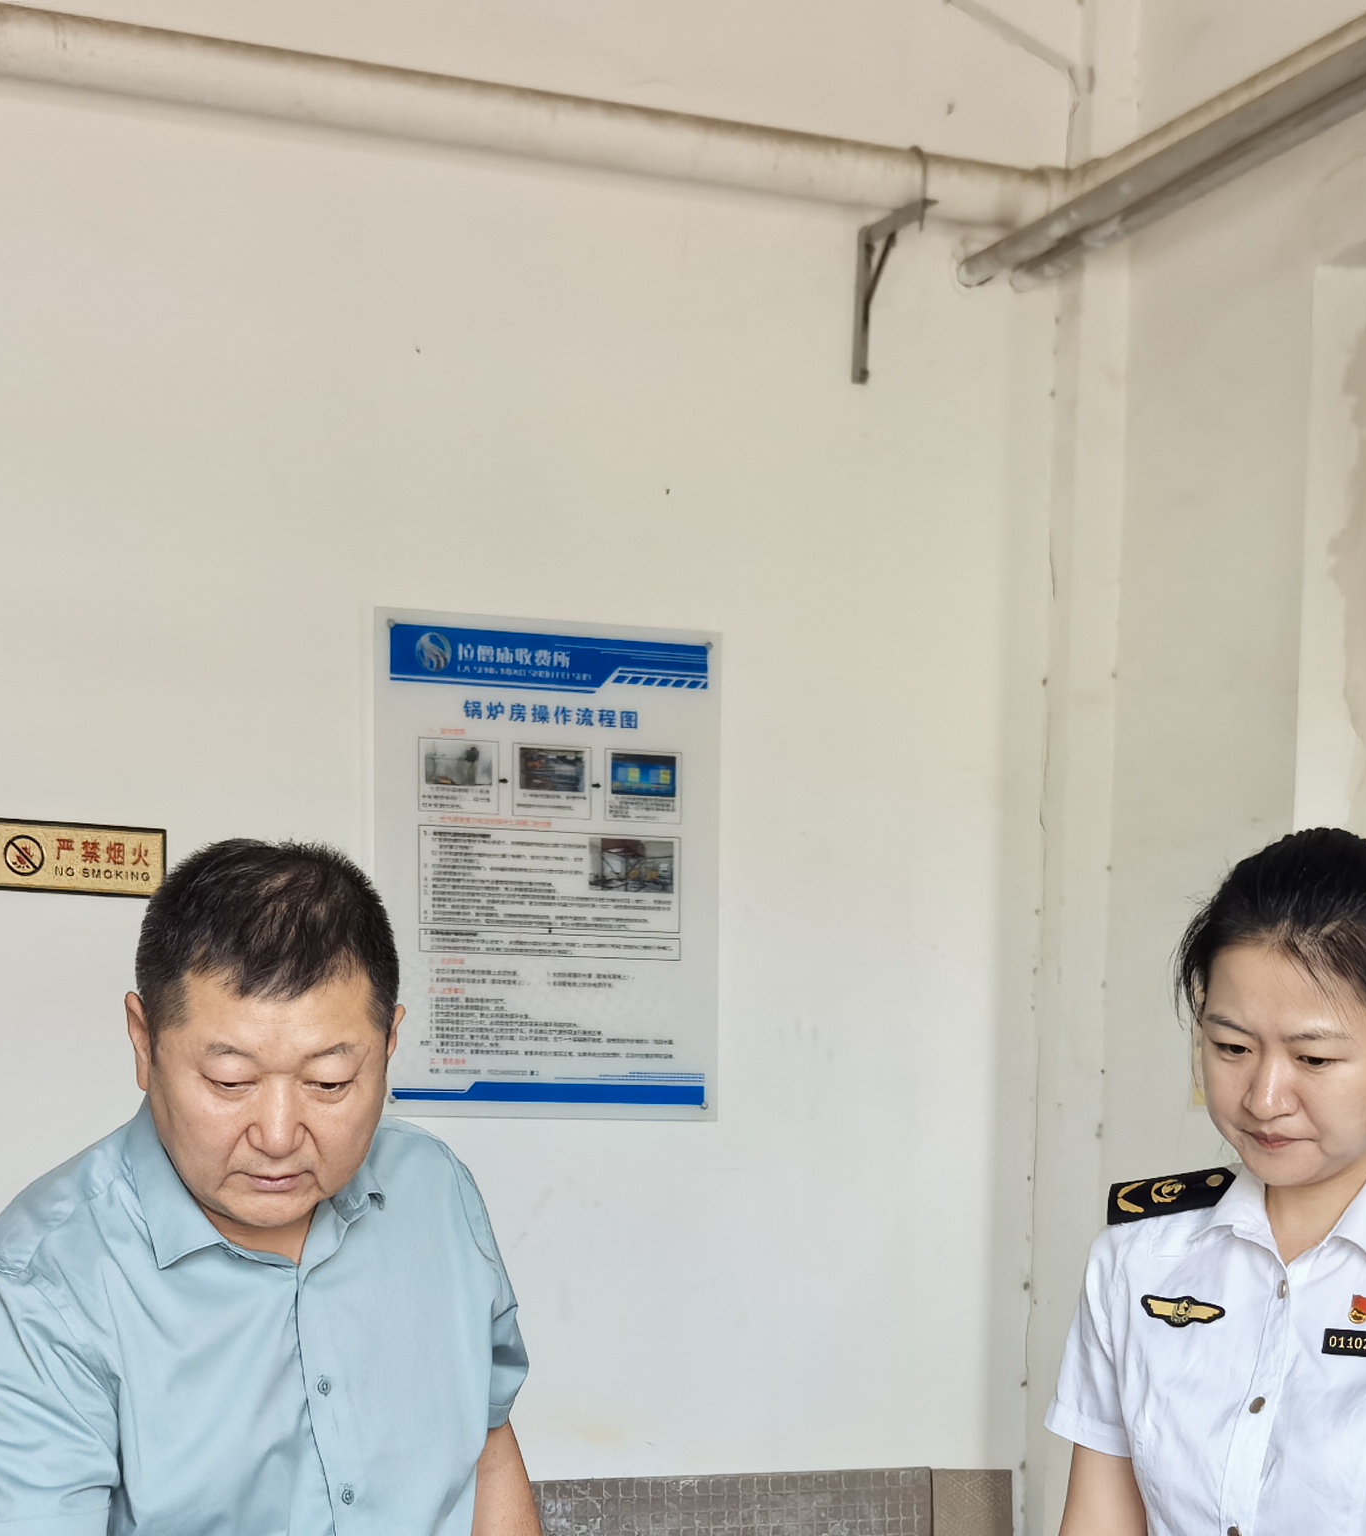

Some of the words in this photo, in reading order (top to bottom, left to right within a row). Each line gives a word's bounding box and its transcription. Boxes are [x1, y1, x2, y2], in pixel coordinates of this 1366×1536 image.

[463, 700, 639, 729] 锅炉房操作流程图
[54, 838, 151, 867] 严禁烟火
[54, 866, 75, 877] NO
[81, 868, 151, 882] SMOKING
